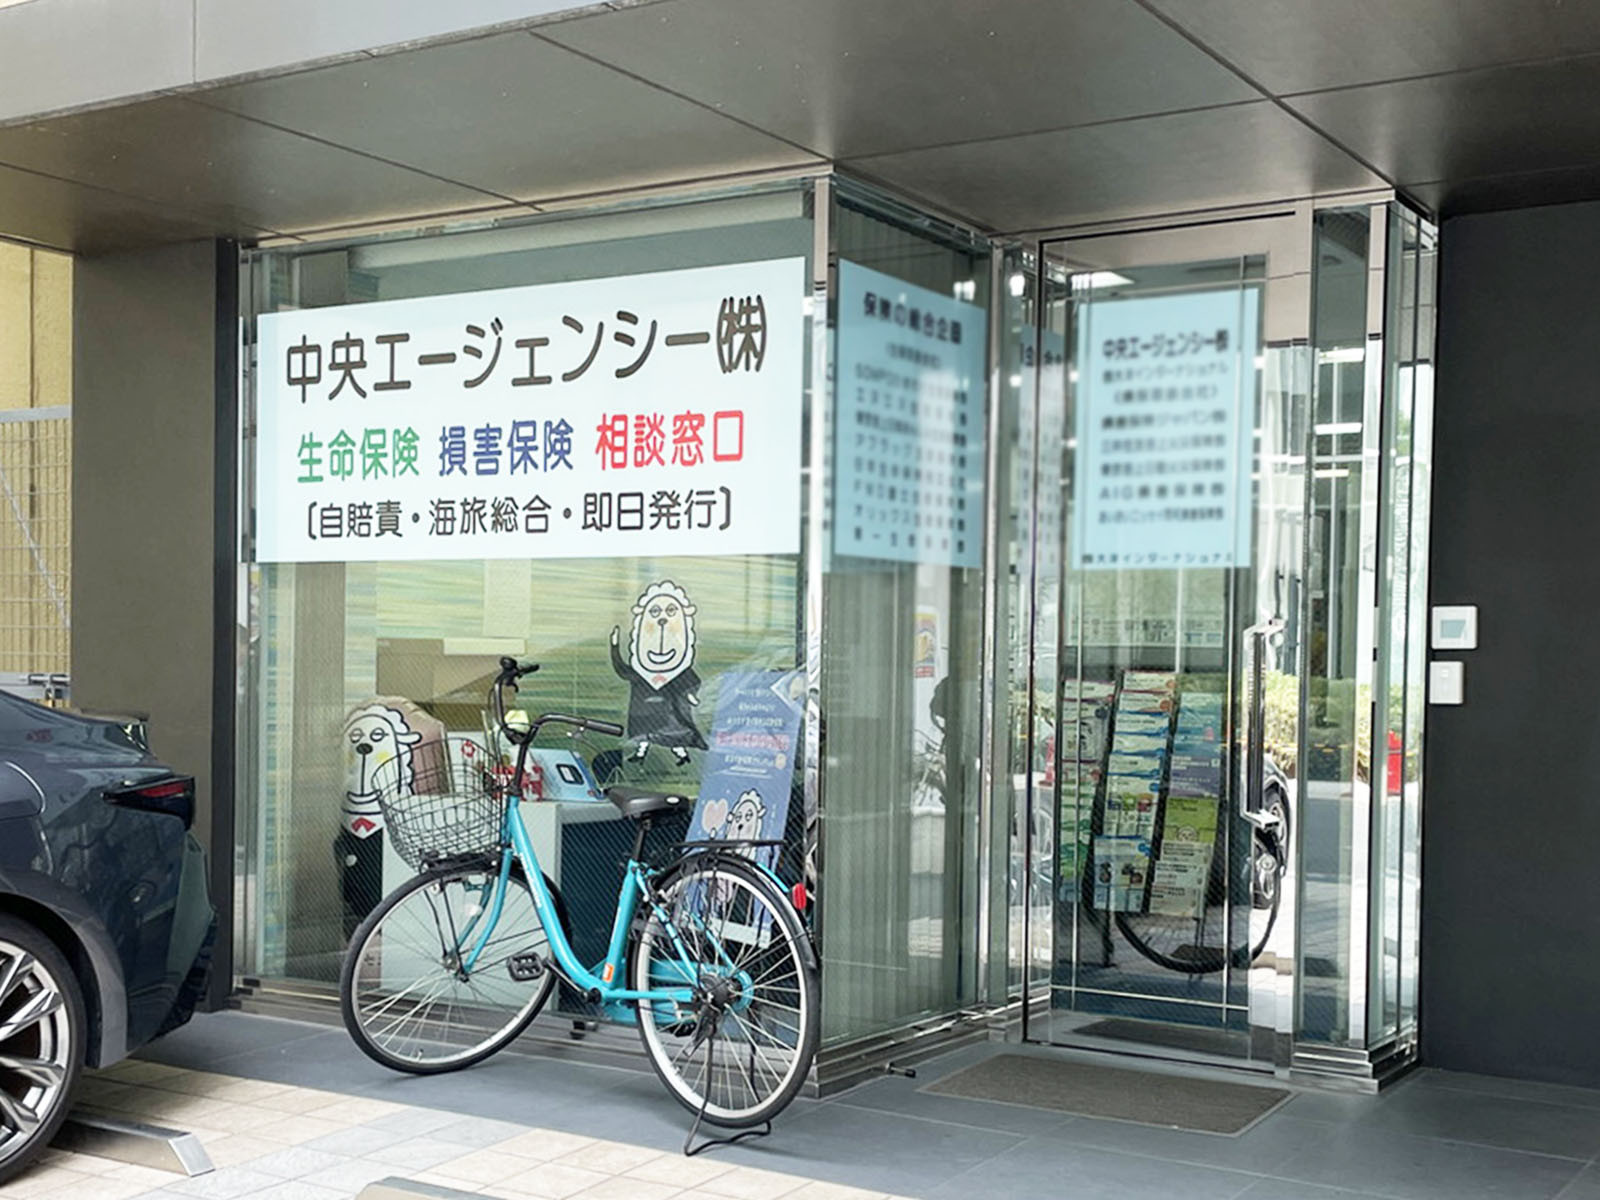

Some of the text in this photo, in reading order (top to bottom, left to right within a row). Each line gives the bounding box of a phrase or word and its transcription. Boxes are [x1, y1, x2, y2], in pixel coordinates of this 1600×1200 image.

[298, 410, 743, 483] 生命保険 損害保険 相談窓口
